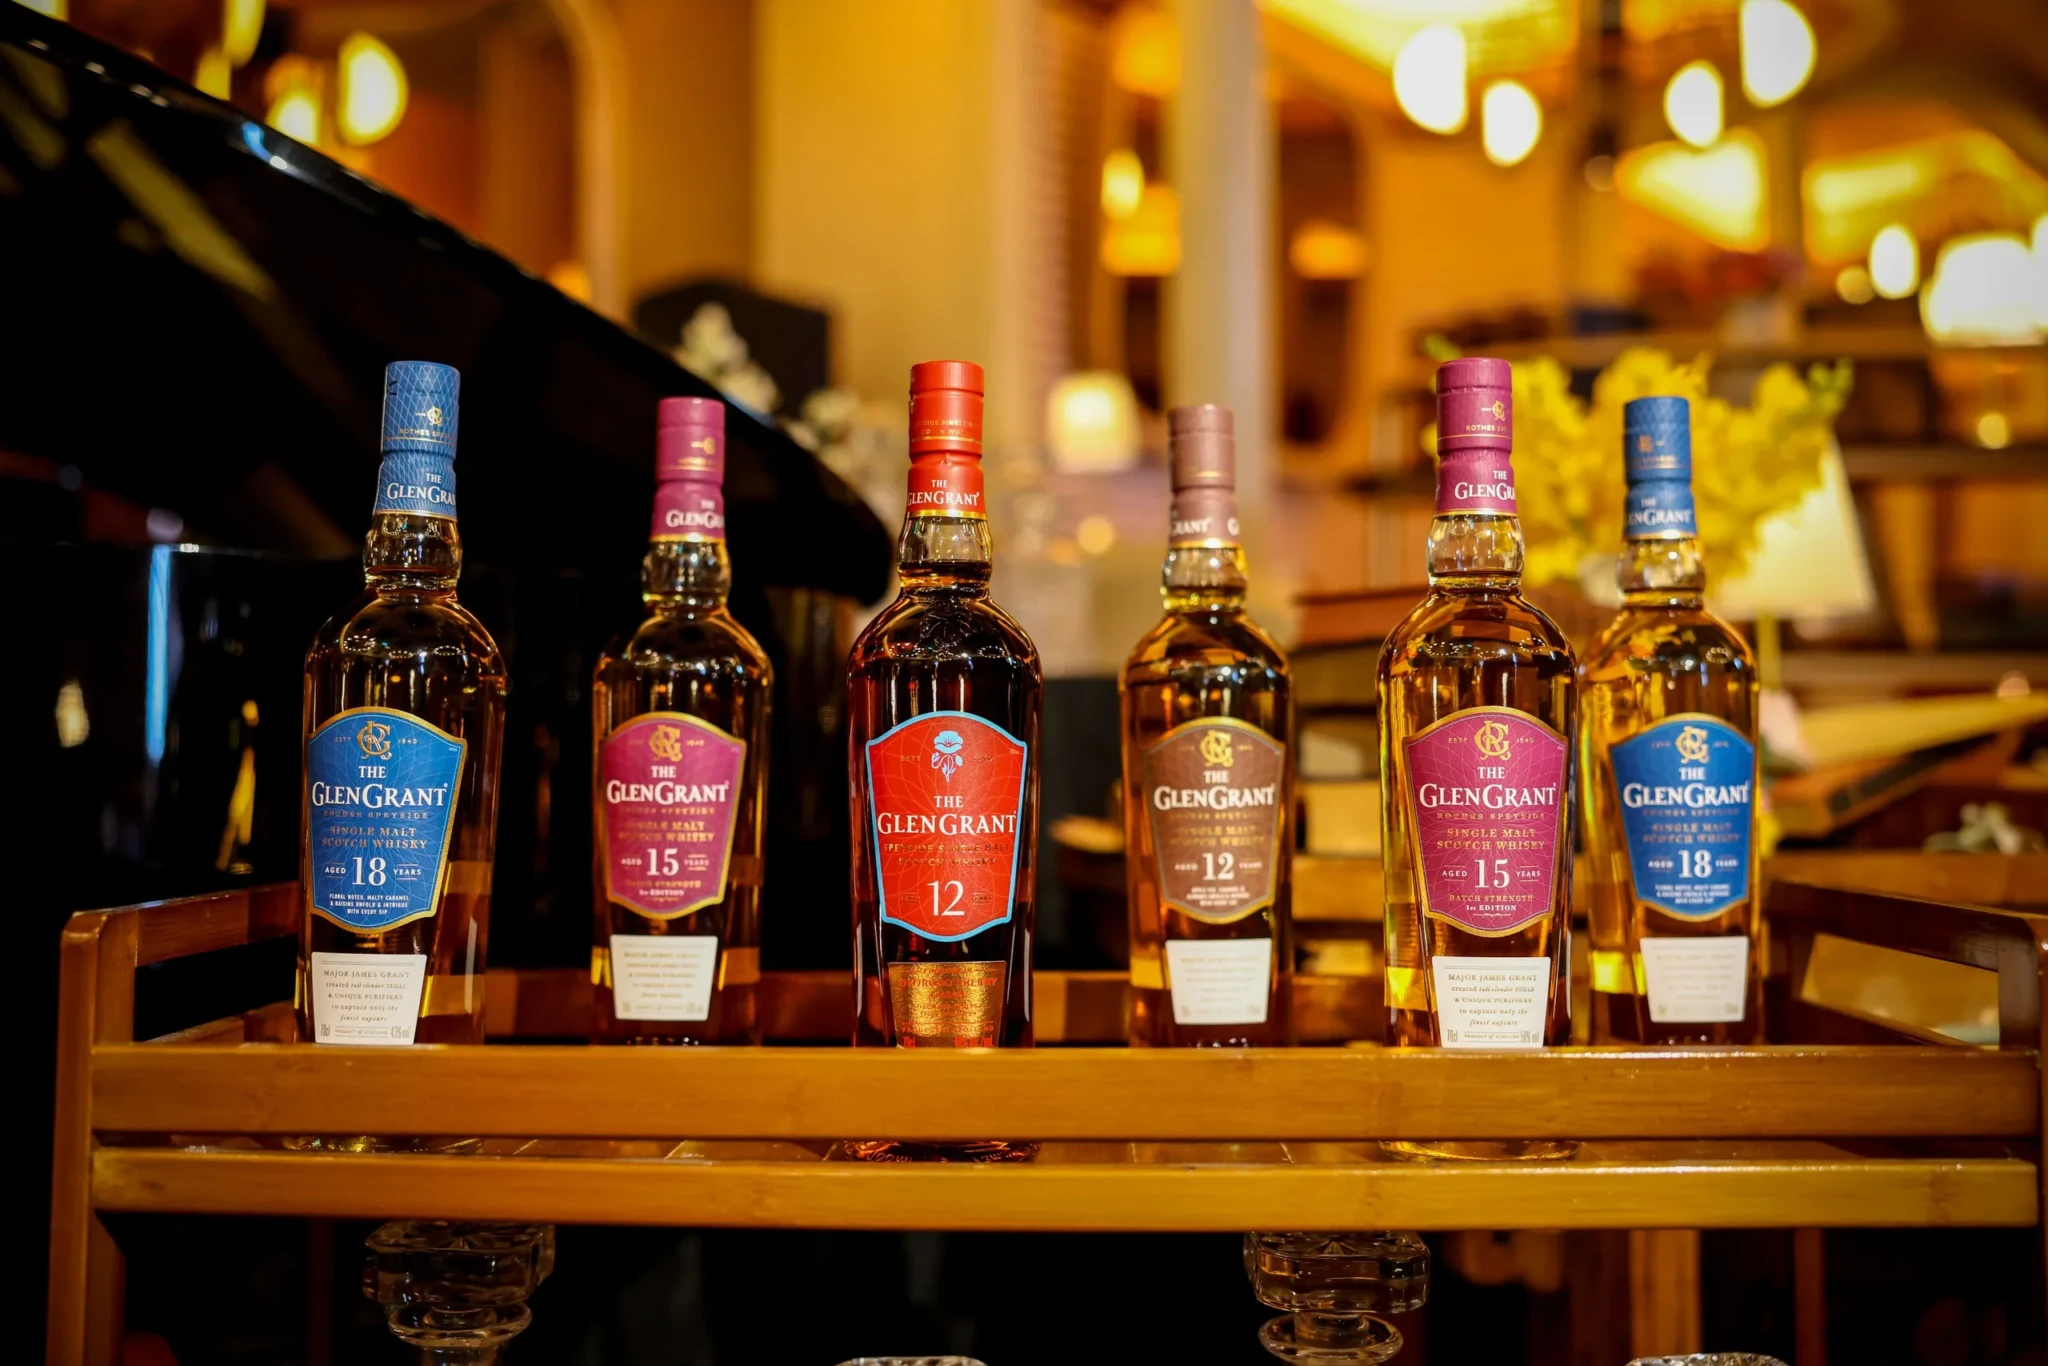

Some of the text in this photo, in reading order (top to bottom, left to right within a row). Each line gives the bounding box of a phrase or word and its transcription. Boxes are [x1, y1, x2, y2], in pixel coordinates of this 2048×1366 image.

[400, 428, 429, 436] ROTHES
[425, 473, 441, 483] THE
[1493, 470, 1507, 480] THE
[932, 480, 948, 488] THE
[359, 766, 386, 778] THE
[651, 766, 676, 778] THE
[1203, 771, 1229, 783] THE
[1477, 766, 1505, 779] THE
[1679, 767, 1705, 780] THE
[312, 782, 447, 808] GLENGRANT
[607, 780, 729, 805] GLENGRANT
[1154, 784, 1275, 810] GLENGRANT
[1419, 783, 1556, 808] GLENGRANT
[1624, 782, 1750, 808] GLENGRANT
[934, 796, 963, 808] THE
[368, 811, 428, 819] SPEYSIDE
[1437, 812, 1484, 820] ROTHES
[672, 821, 705, 831] MALT
[878, 812, 1016, 835] GLENGRANT
[330, 826, 417, 837] SINGLE MALT
[1447, 829, 1536, 838] SINGLE MALT
[322, 839, 428, 849] SCOTCH WHISKY
[985, 844, 1009, 852] MALT
[1437, 841, 1545, 850] SCOTCH WHISKY
[647, 849, 679, 876] 15
[951, 857, 996, 866] WHISKY
[1202, 852, 1234, 880] 12
[1678, 850, 1712, 879] 18
[352, 857, 386, 886] 18
[1474, 859, 1510, 889] 15
[927, 880, 964, 916] 12
[324, 970, 349, 978] MAJOR
[350, 970, 377, 978] JAMES
[1448, 974, 1476, 982] MAJOR
[1479, 974, 1506, 982] JAMES
